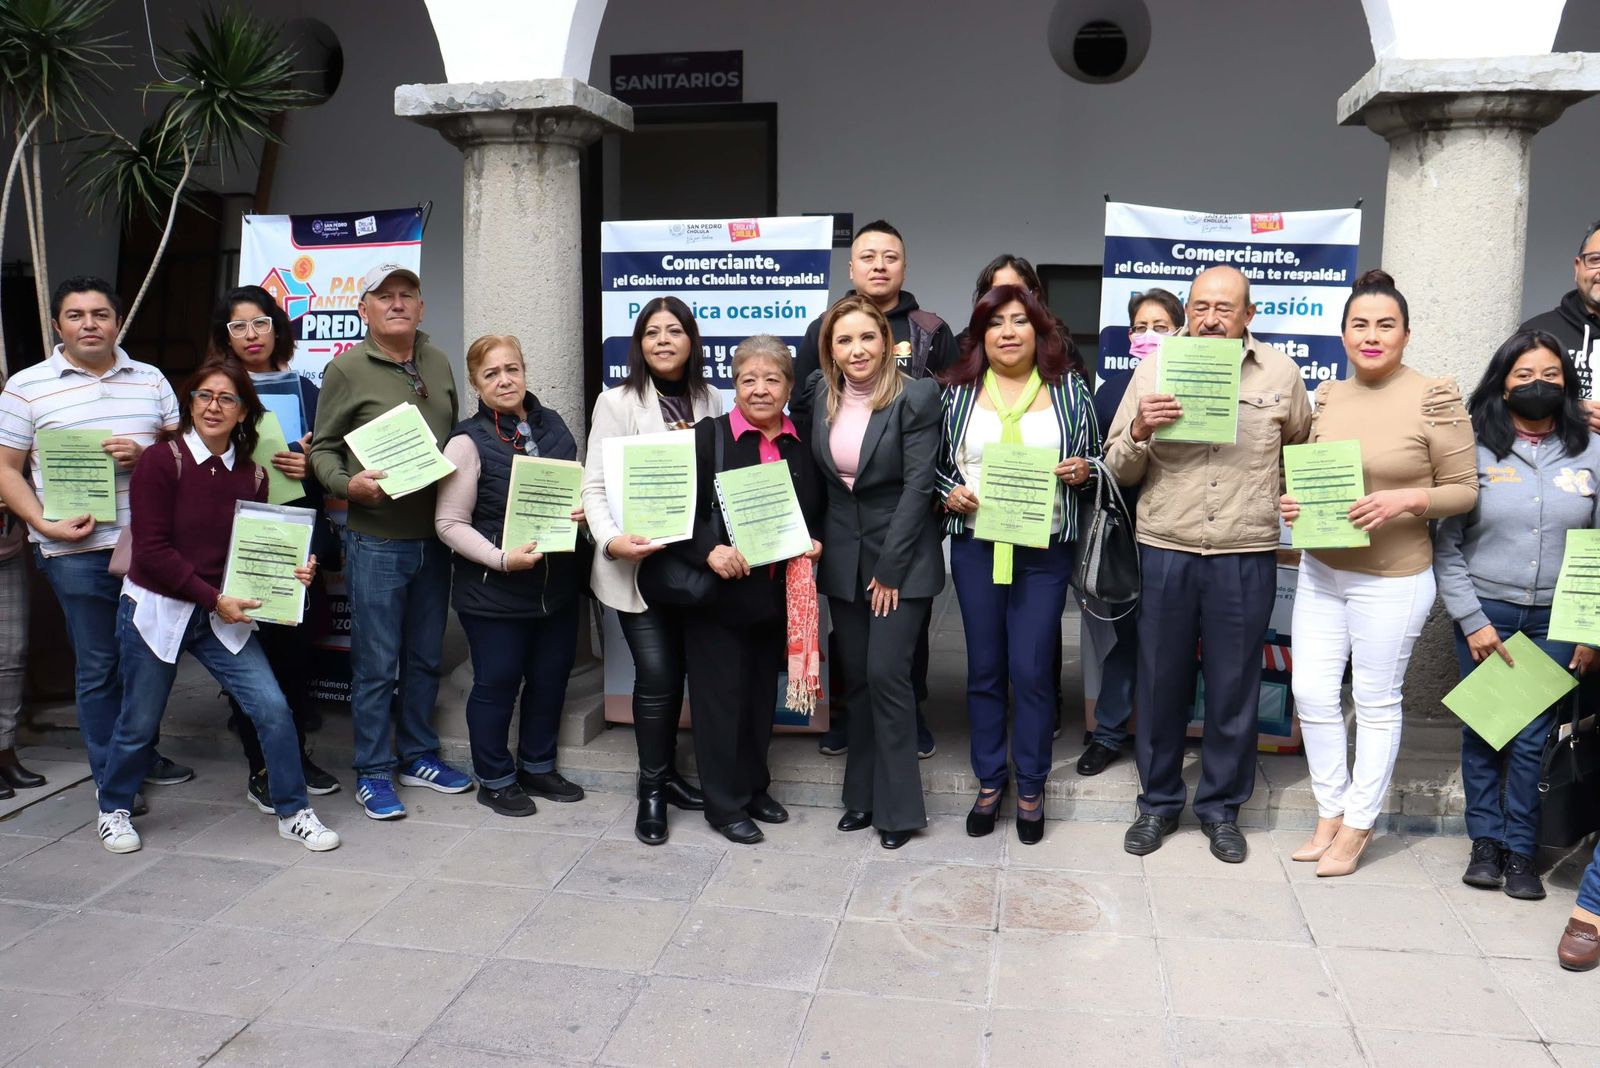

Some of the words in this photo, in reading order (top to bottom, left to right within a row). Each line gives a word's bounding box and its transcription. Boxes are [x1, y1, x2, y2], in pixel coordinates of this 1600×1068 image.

[615, 71, 740, 91] SANITARIOS
[661, 253, 780, 272] Comerciante,
[1171, 243, 1301, 267] Comerciante,
[612, 274, 628, 288] ¡el
[629, 274, 683, 286] Gobierno
[684, 273, 700, 285] de
[702, 273, 748, 286] Cholula
[749, 274, 764, 285] te
[765, 272, 825, 287] respalda!
[1114, 260, 1132, 275] ¡el
[1133, 261, 1194, 276] Gobierno
[1267, 268, 1282, 280] te
[1283, 267, 1347, 282] respalda!
[314, 295, 359, 309] ANTIC
[726, 299, 807, 319] ocasión
[1254, 296, 1323, 316] casión
[714, 345, 726, 362] y
[319, 678, 349, 690] número
